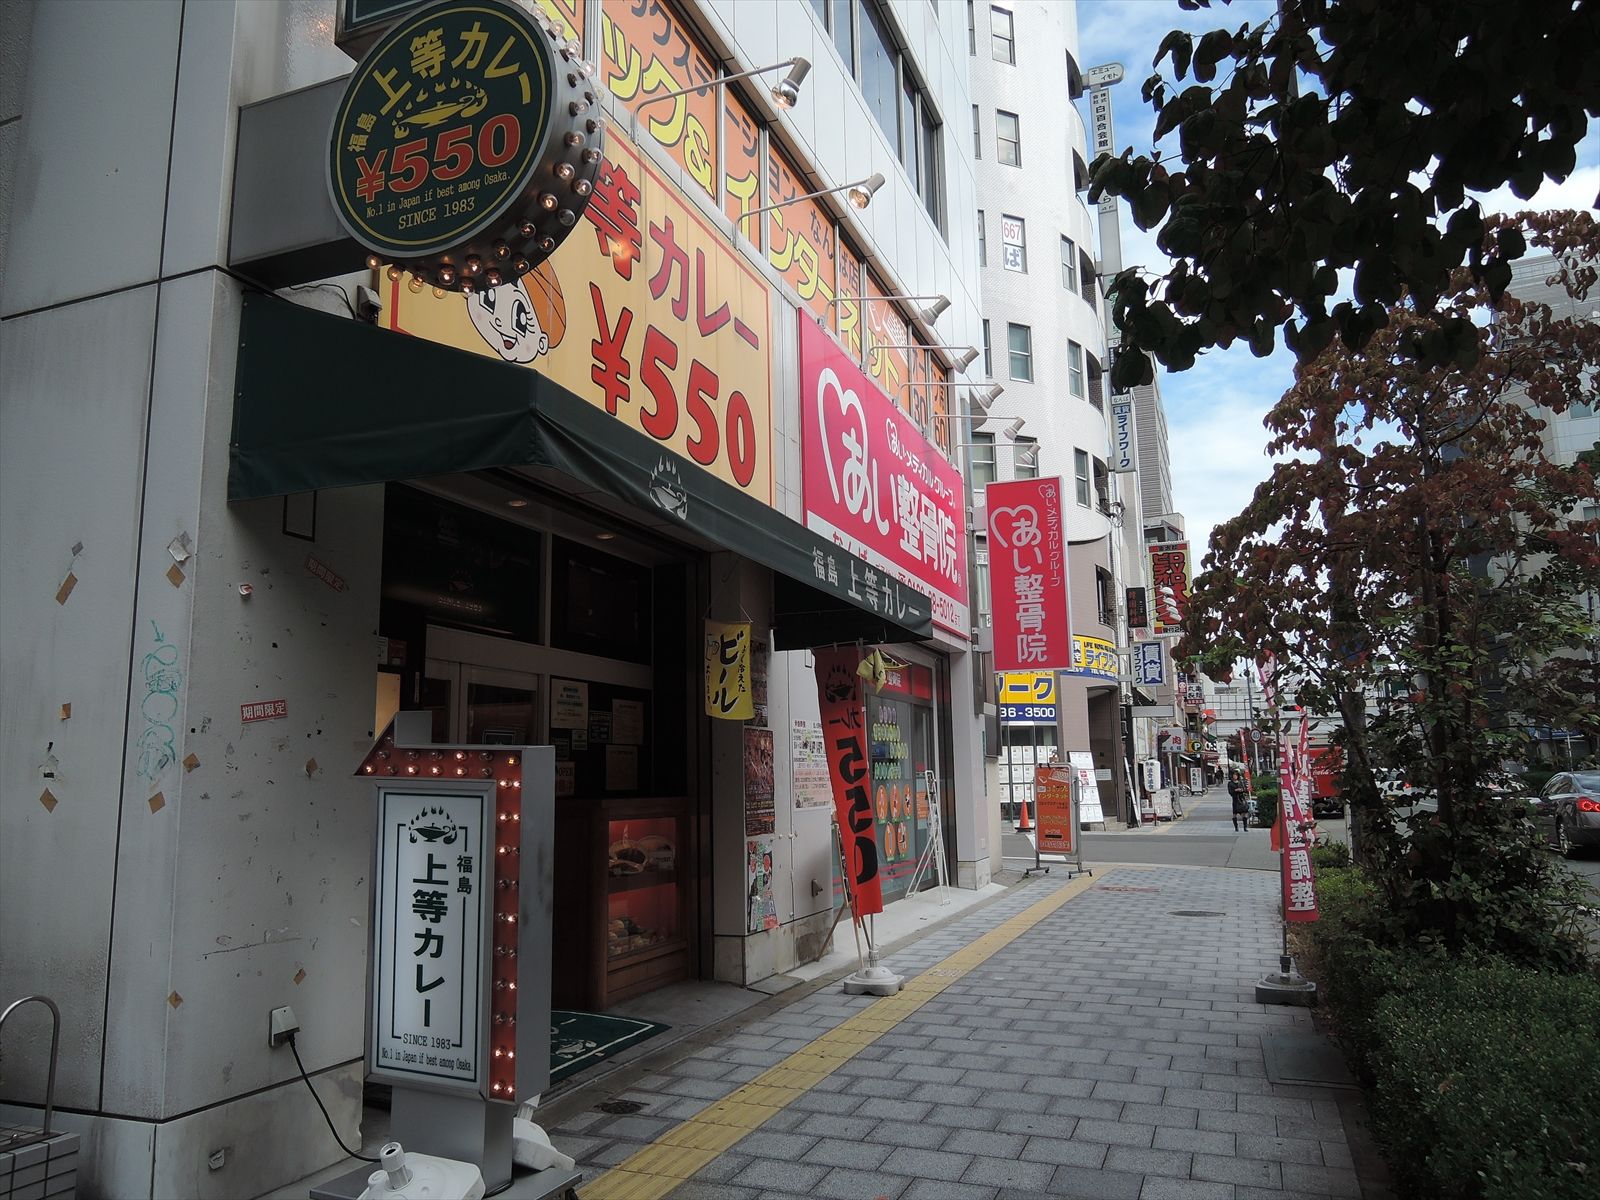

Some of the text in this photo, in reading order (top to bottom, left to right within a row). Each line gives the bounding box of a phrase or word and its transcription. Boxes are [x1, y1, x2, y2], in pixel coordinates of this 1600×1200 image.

[348, 22, 531, 152] 福島 上等カレー
[1091, 65, 1116, 76] エミュー
[356, 113, 521, 203] ¥550
[366, 170, 511, 218] No.1 in Japan if best among Osaka.
[398, 197, 475, 231] SINCE 1983
[1004, 222, 1020, 240] 667
[1005, 247, 1021, 267] ば
[589, 281, 757, 487] ¥550
[1117, 415, 1130, 468] ライフワーク
[838, 428, 958, 585] あい整骨院
[812, 546, 920, 620] 福島 上等カレー
[1012, 517, 1048, 663] あい整骨院
[713, 630, 744, 713] ビール
[1134, 646, 1143, 684] ライフワーク
[242, 701, 287, 721] 期間限定
[457, 854, 473, 895] 福島
[412, 853, 449, 1027] 上等カレー
[382, 1047, 393, 1060] No.1
[395, 1050, 401, 1061] in
[402, 1050, 417, 1065] Japan
[418, 1052, 424, 1063] if
[426, 1053, 437, 1066] best
[440, 1058, 454, 1071] among
[403, 1033, 451, 1050] SINCE 1983
